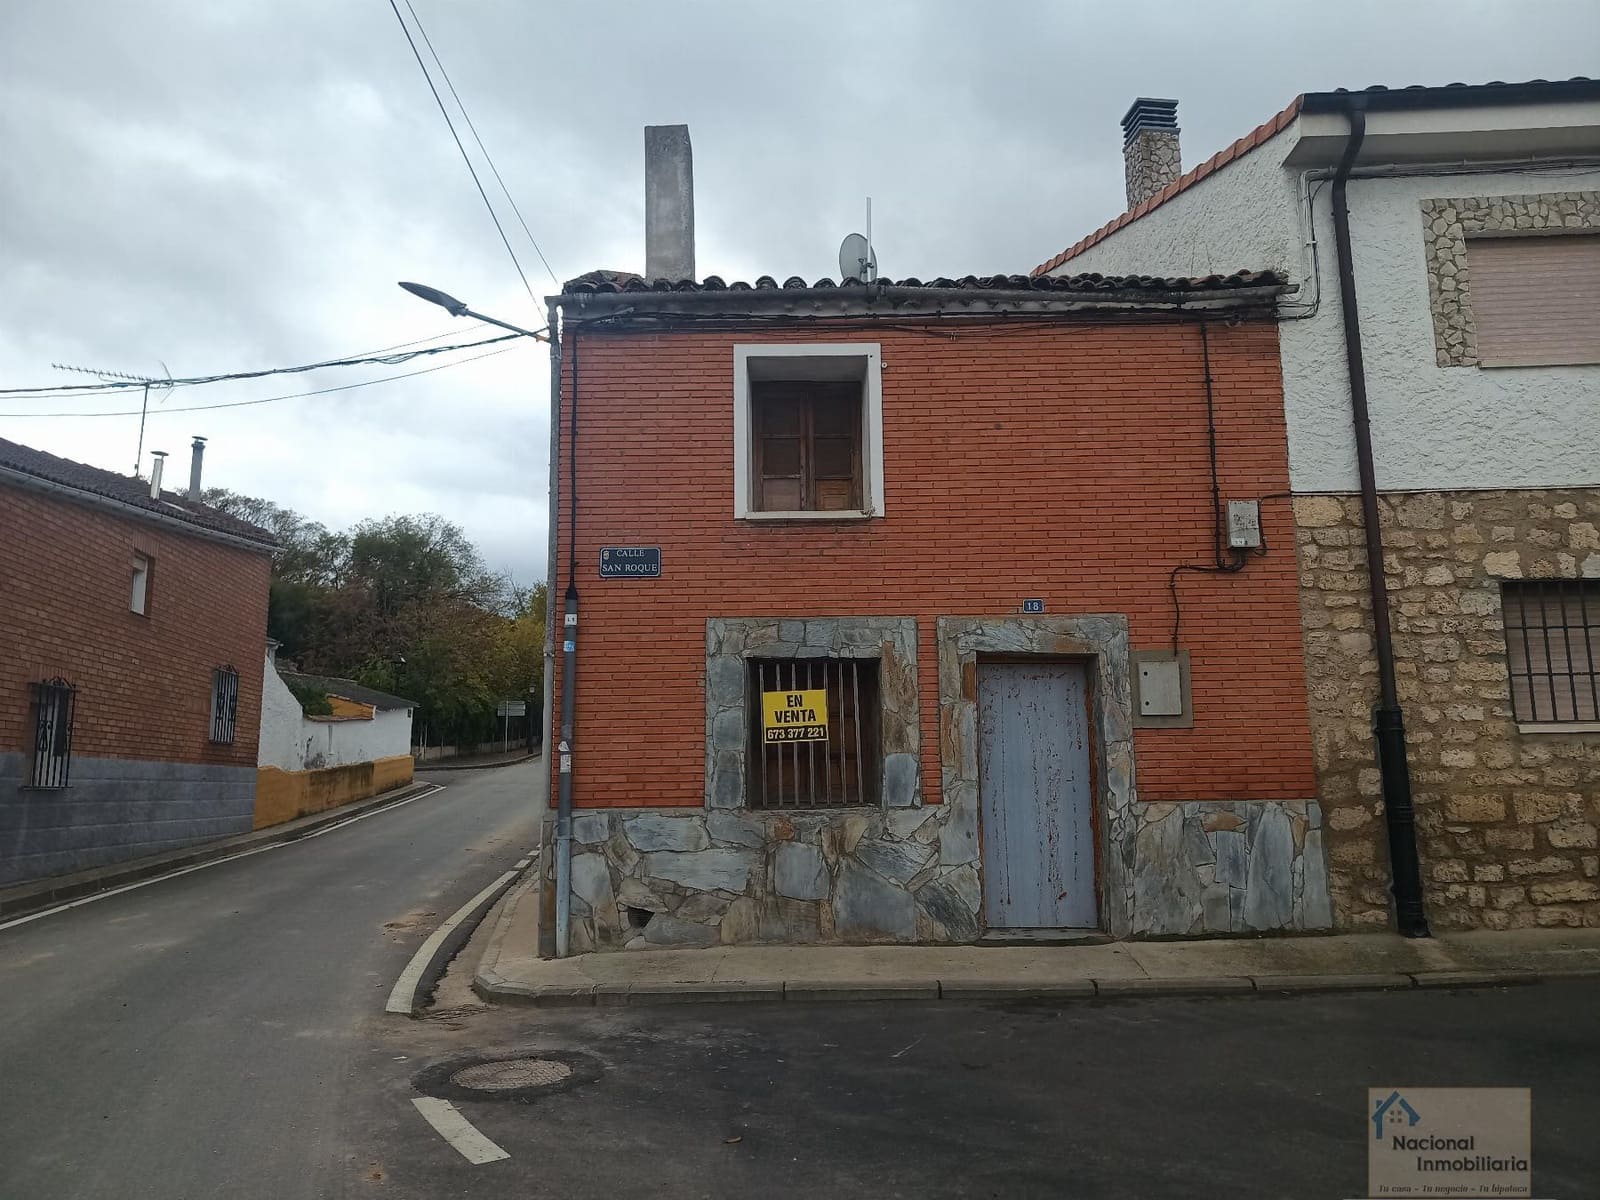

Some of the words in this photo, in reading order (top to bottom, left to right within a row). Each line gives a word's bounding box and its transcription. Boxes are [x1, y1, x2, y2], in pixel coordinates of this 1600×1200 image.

[616, 549, 645, 557] CALLE
[602, 563, 622, 572] SAN
[625, 563, 658, 573] ROQUE
[1028, 602, 1039, 611] 18
[786, 694, 803, 708] EN
[774, 708, 817, 724] VENTA
[767, 728, 785, 740] 673
[787, 727, 805, 739] 377
[807, 727, 824, 738] 221
